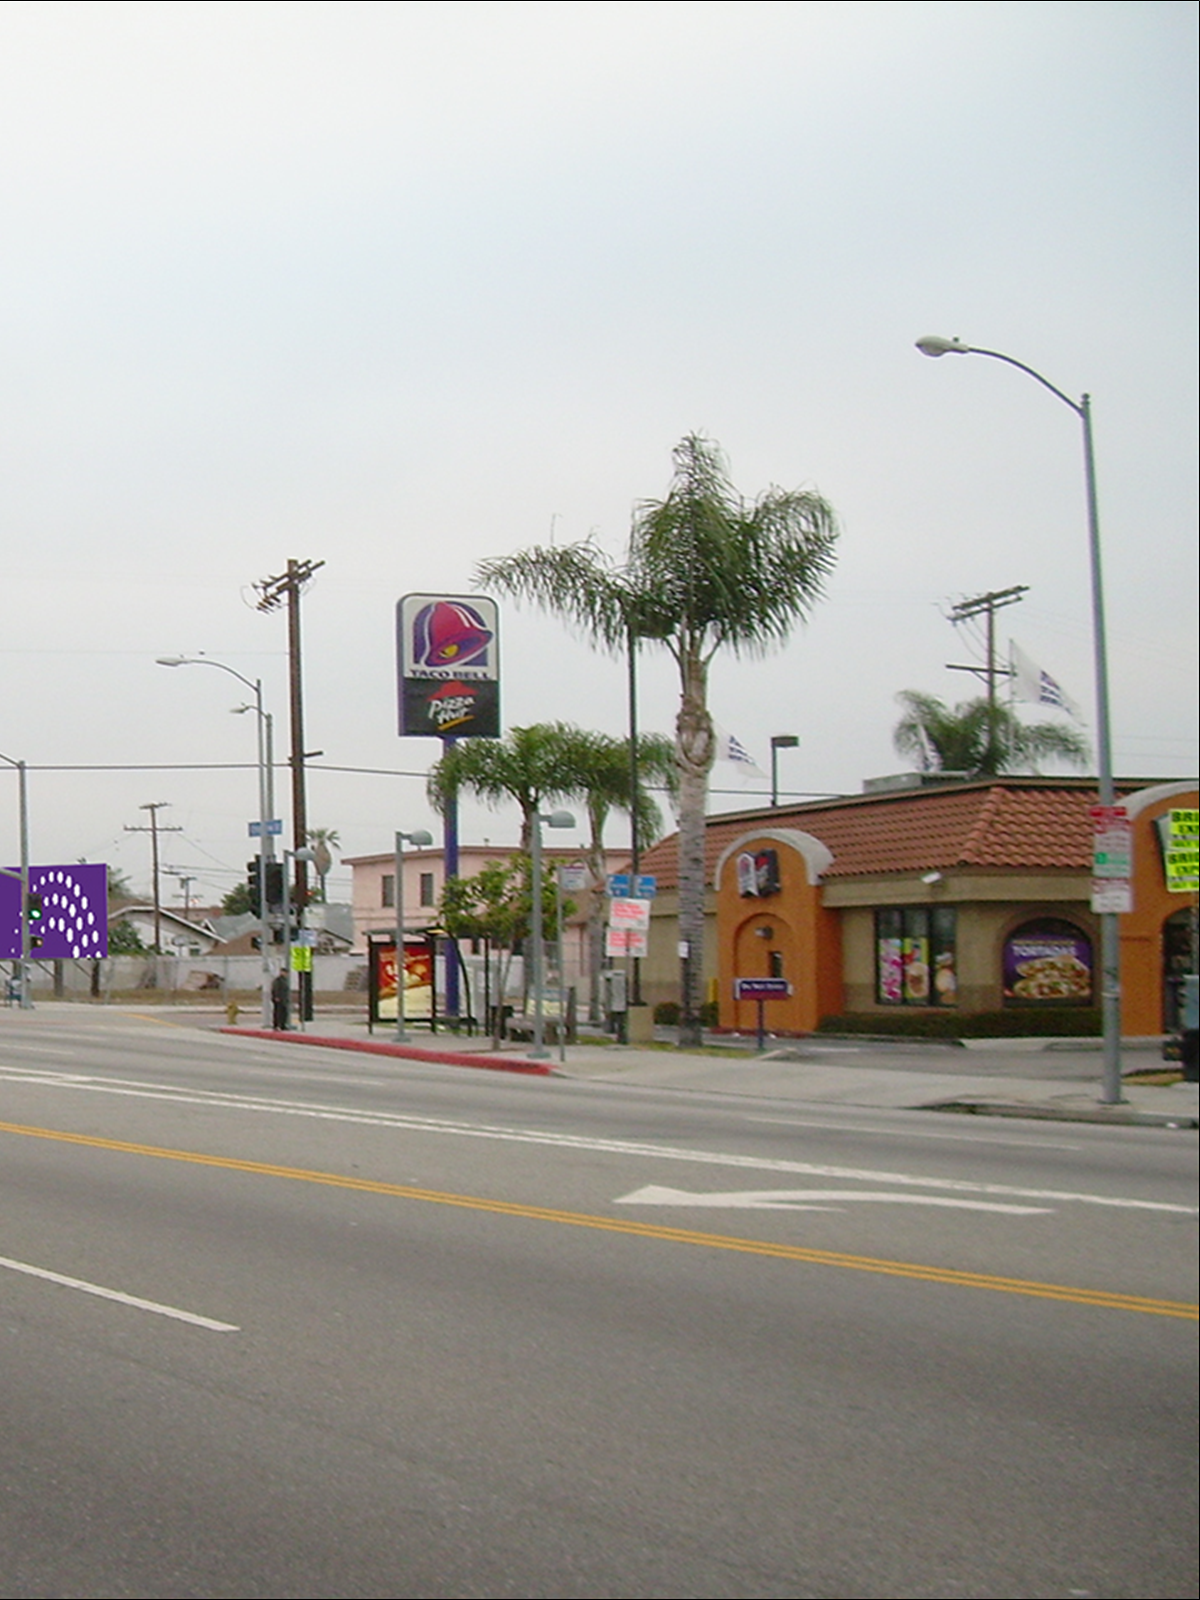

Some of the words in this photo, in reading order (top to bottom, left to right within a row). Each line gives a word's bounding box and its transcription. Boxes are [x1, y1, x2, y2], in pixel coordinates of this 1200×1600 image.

[410, 668, 450, 679] TACO
[452, 671, 490, 680] BELL
[428, 696, 476, 719] Pizza
[436, 708, 470, 724] Hut
